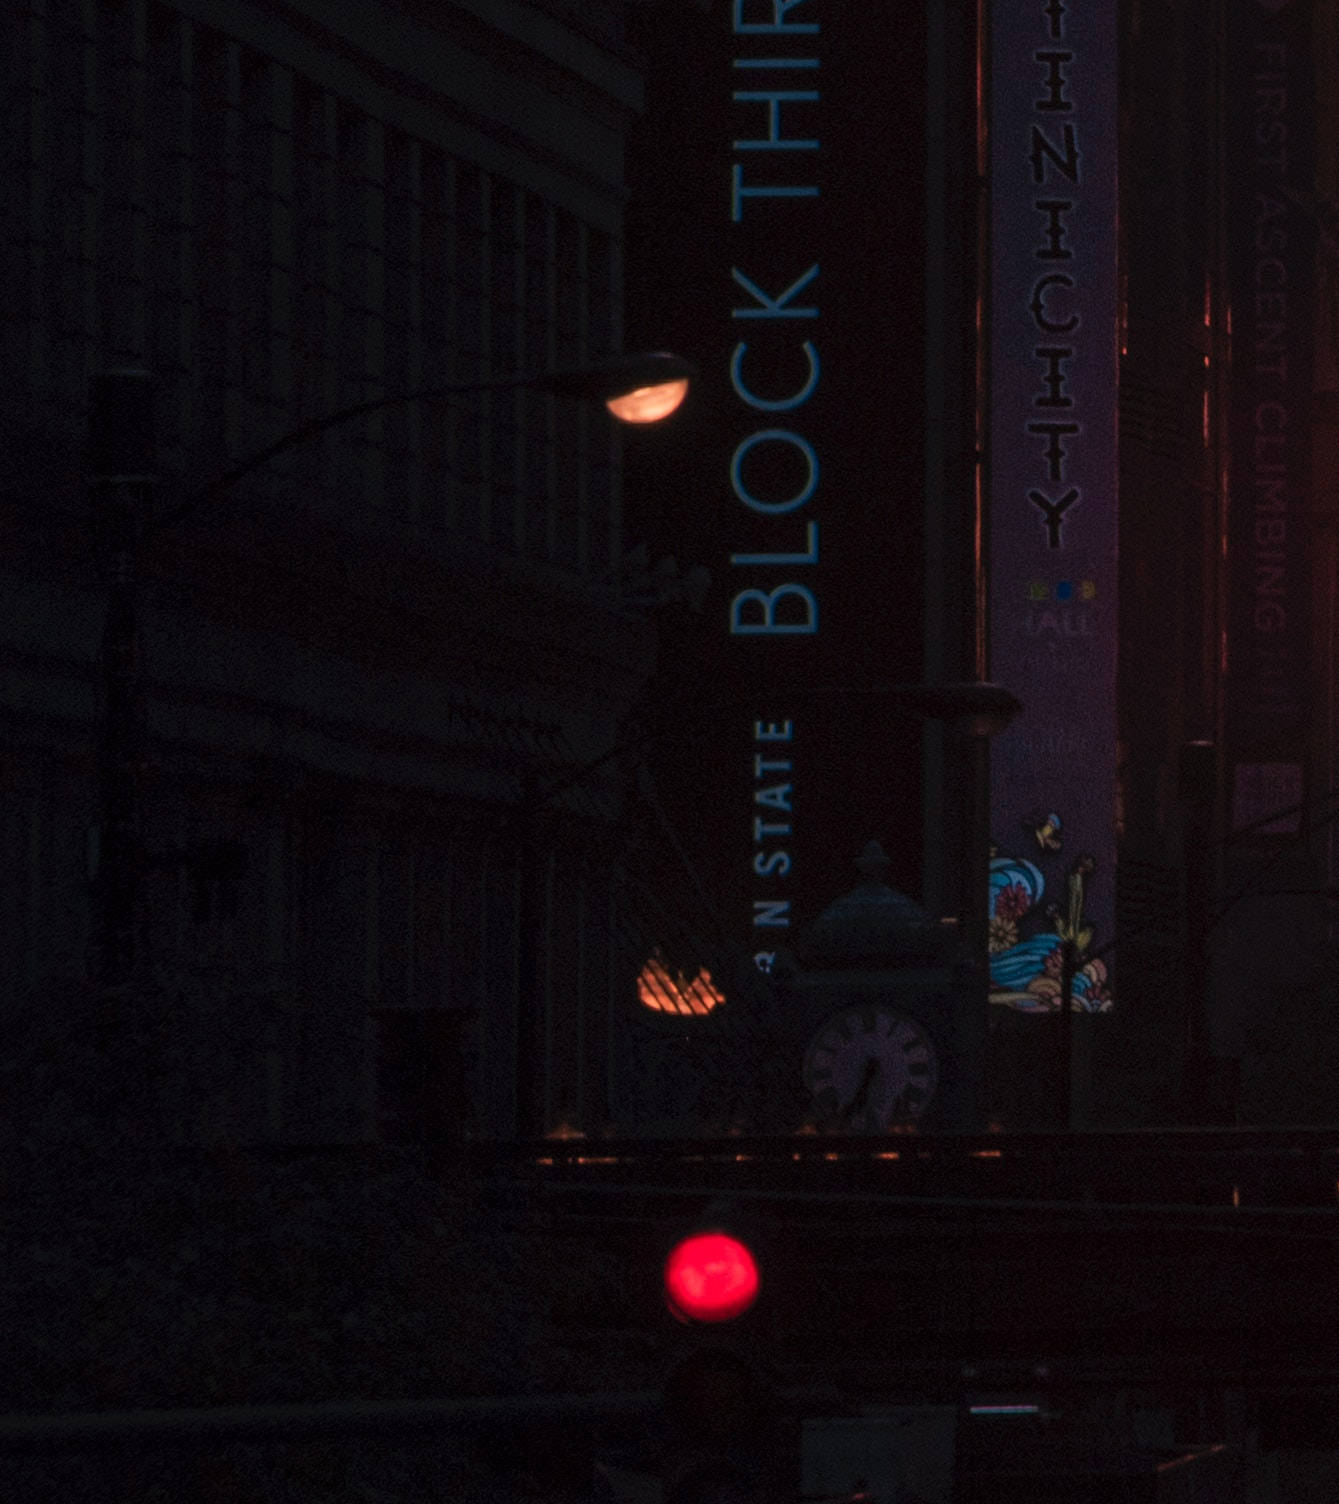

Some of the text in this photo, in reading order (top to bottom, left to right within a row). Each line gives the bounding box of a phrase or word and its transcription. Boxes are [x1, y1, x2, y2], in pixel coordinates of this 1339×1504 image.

[1253, 43, 1287, 176] FIRST
[1253, 193, 1287, 382] ASCENT
[730, 263, 822, 637] BLOCK
[1253, 399, 1287, 632] CLIMBING
[753, 717, 794, 878] STATE
[753, 899, 792, 929] N
